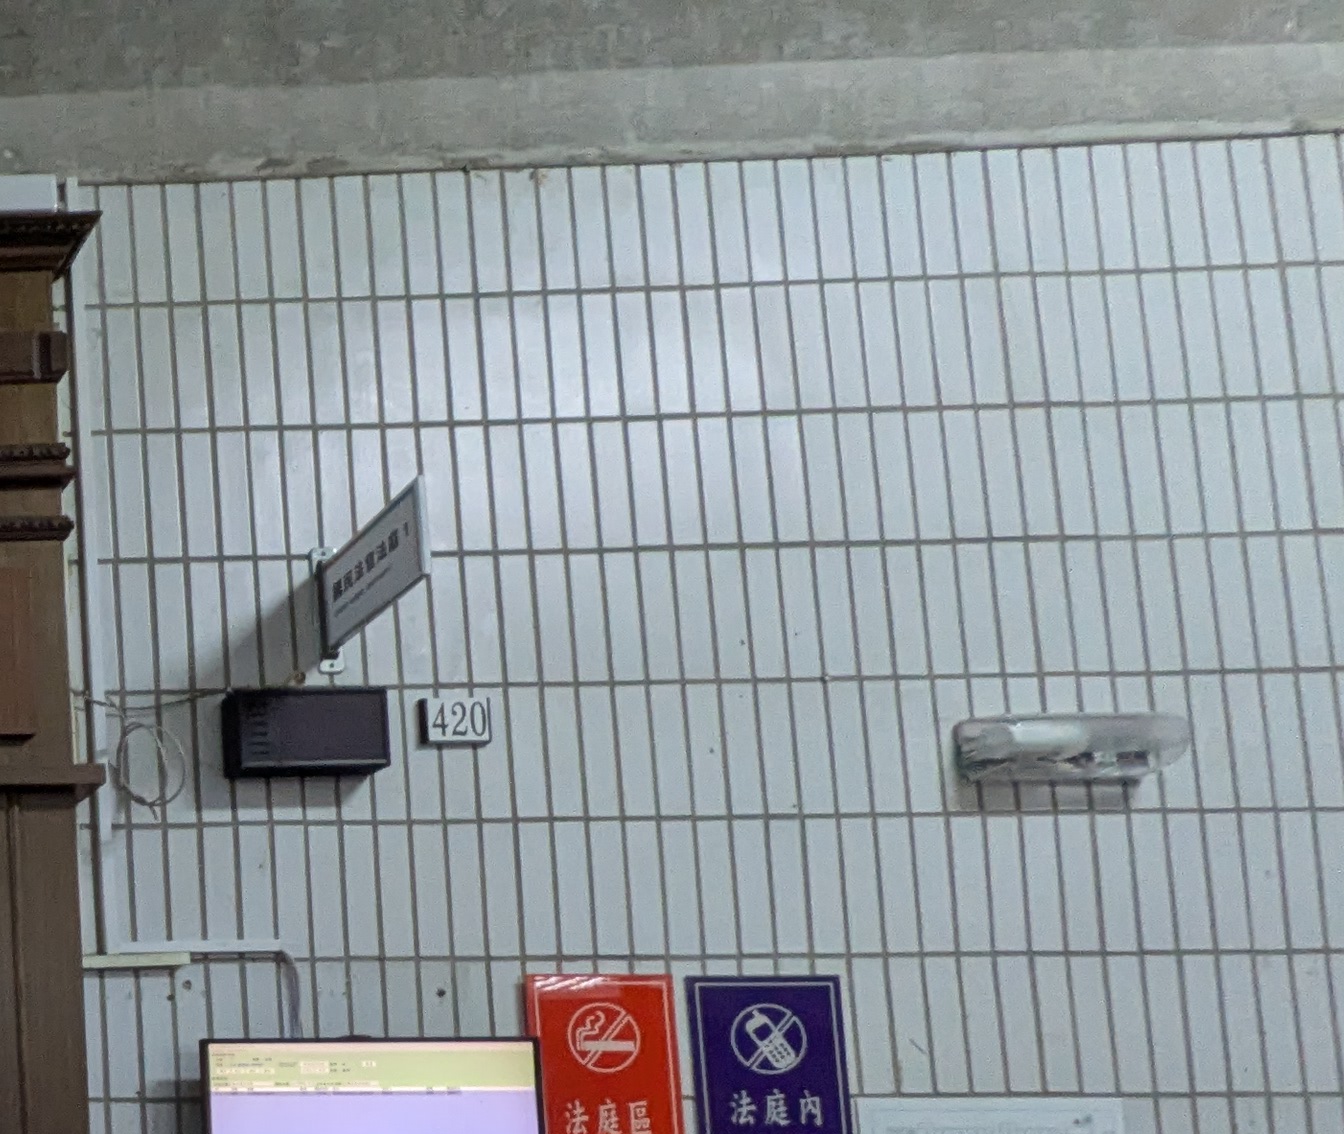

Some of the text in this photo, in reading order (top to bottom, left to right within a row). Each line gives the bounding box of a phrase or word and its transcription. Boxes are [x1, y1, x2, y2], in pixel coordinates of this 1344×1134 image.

[432, 701, 487, 737] 420
[729, 1088, 824, 1127] 法庭內
